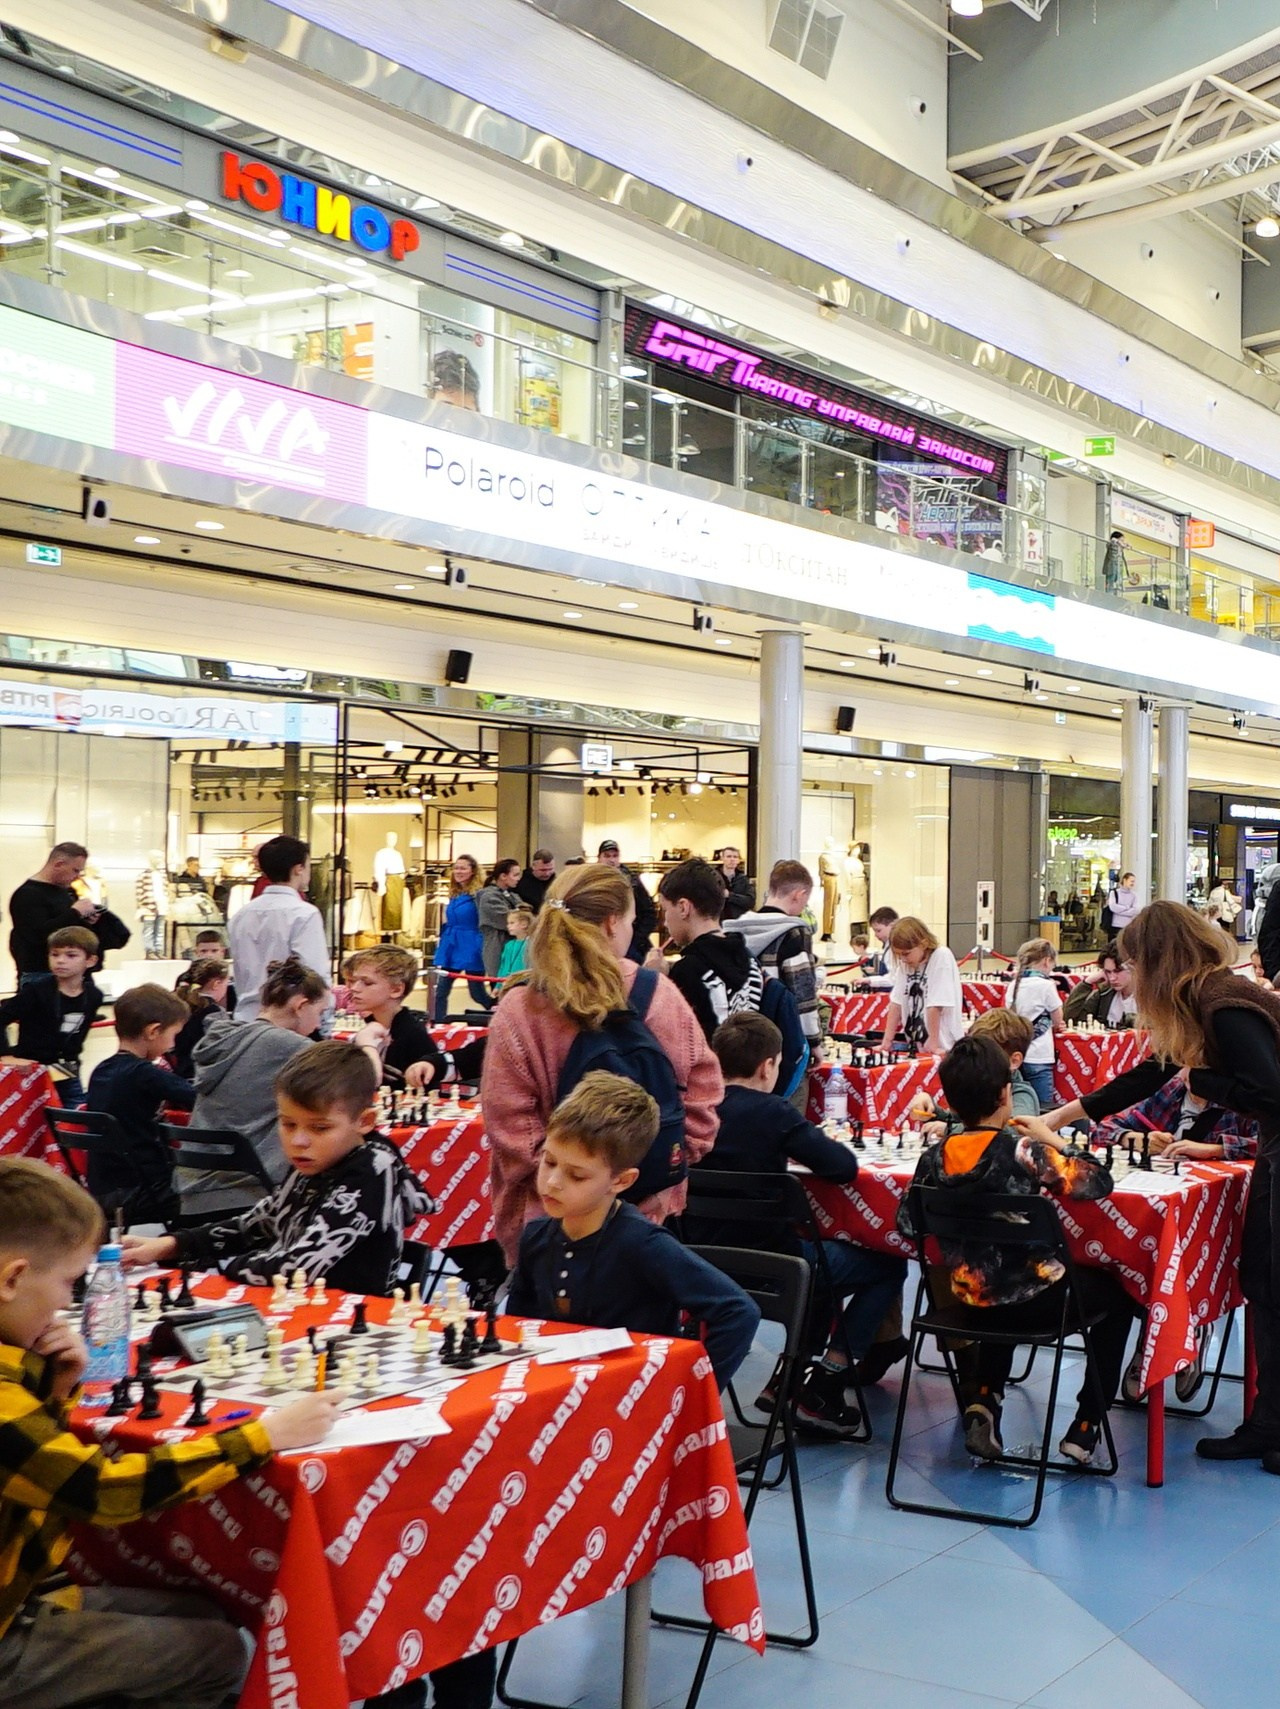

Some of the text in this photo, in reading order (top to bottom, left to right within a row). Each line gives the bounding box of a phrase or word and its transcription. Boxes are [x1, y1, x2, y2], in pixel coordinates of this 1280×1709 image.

[221, 150, 420, 261] ЮНИОР
[163, 381, 330, 461] VIVA
[817, 397, 995, 474] УПРАВЛЯЙ ЗАНОСОМ
[425, 446, 555, 507] Polaroid
[324, 1442, 417, 1568] радуга
[431, 1399, 516, 1515] радуга
[611, 1411, 675, 1517] радуга
[423, 1501, 508, 1624] радуга
[523, 1456, 599, 1568] радуга
[338, 1551, 409, 1657] адуга
